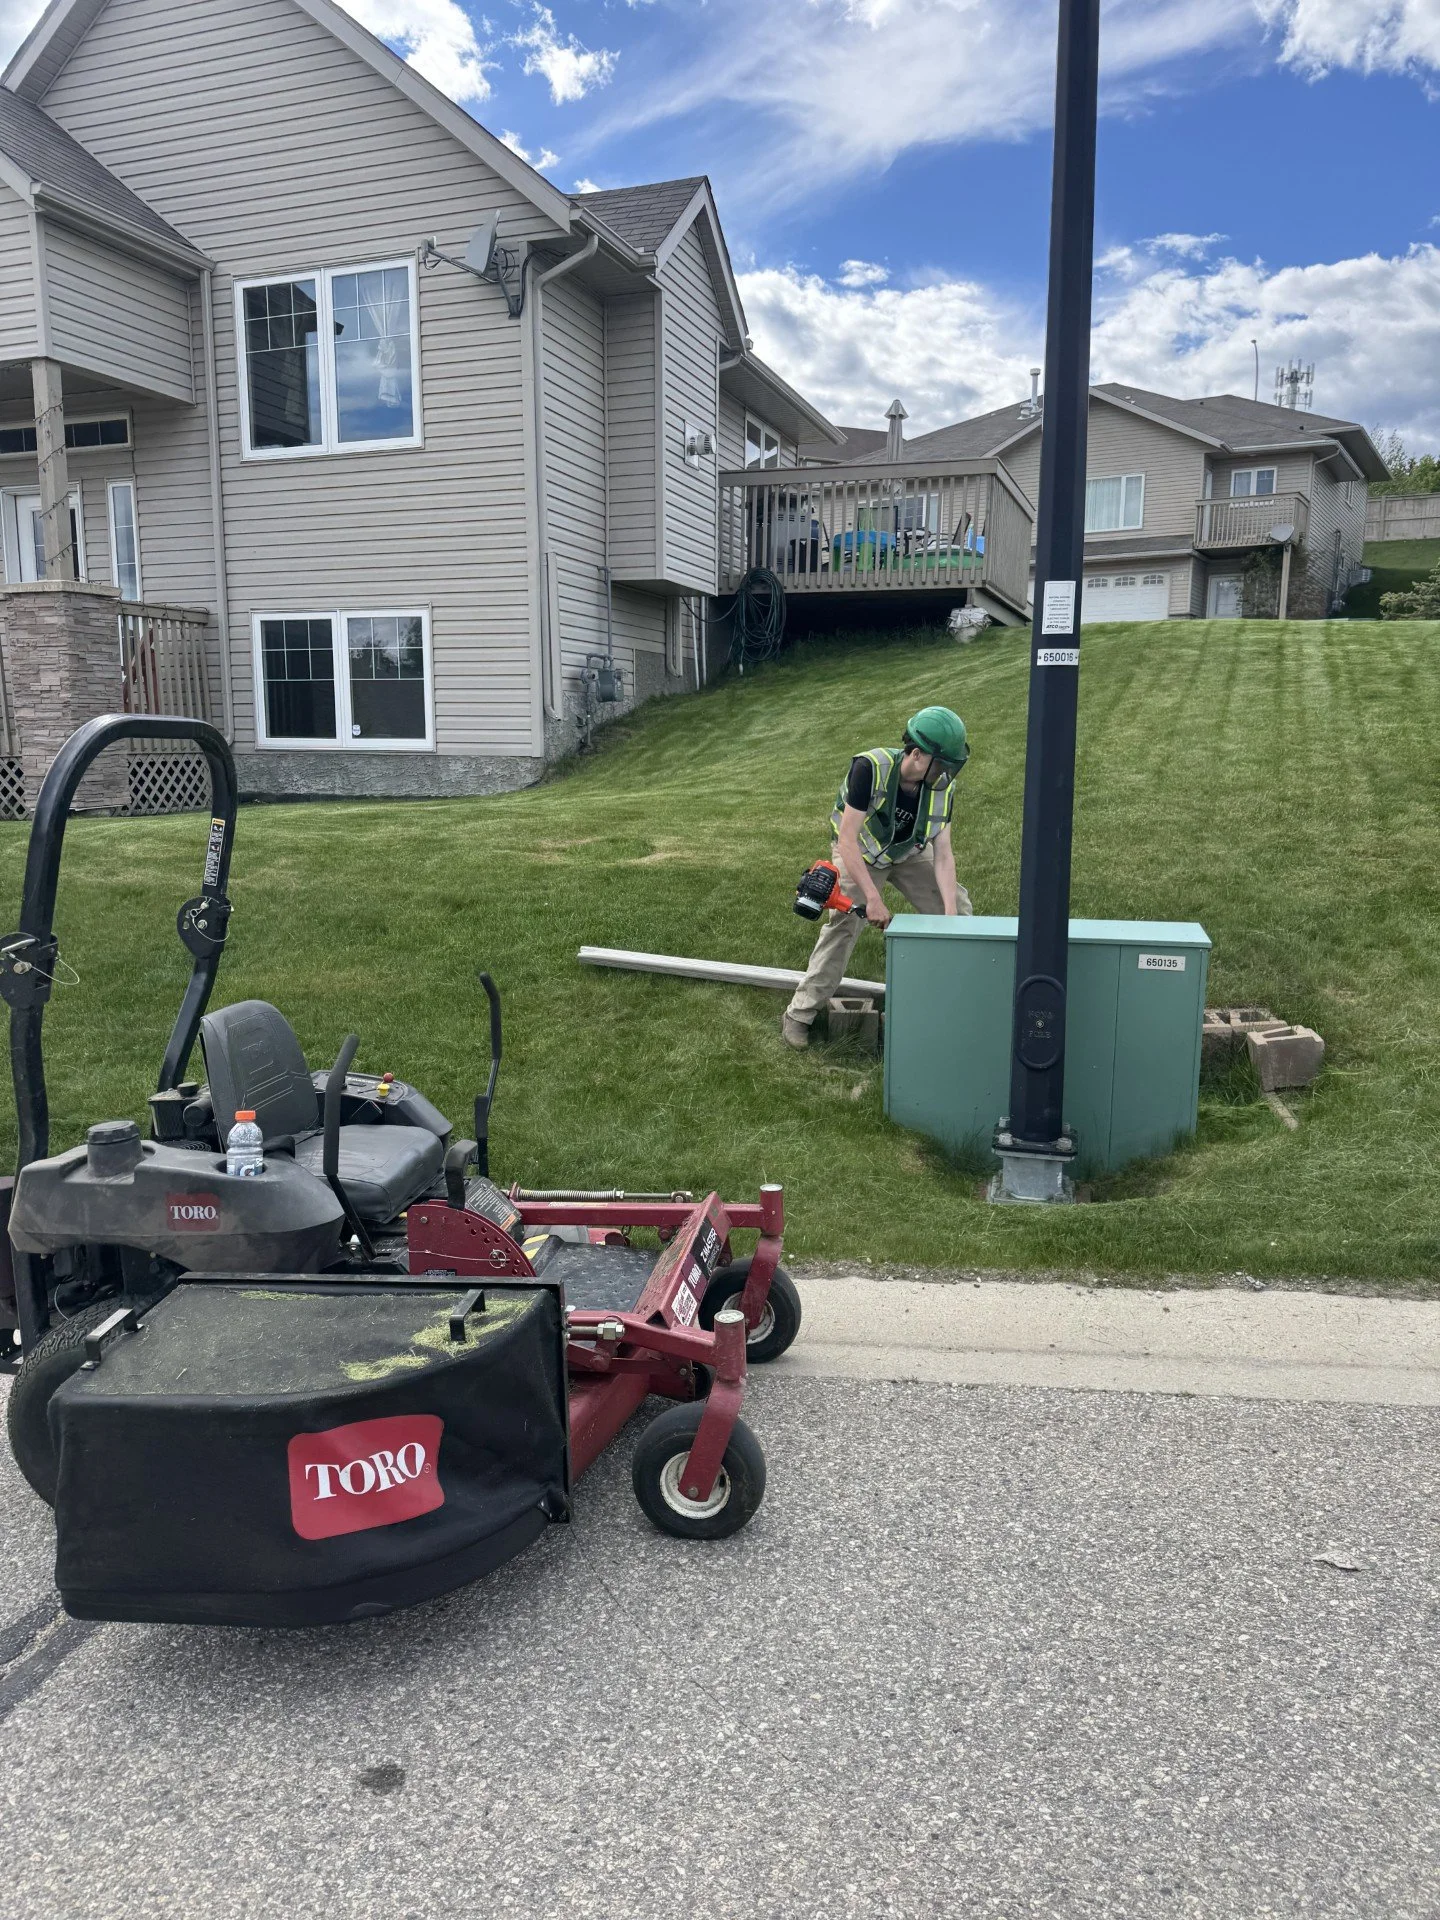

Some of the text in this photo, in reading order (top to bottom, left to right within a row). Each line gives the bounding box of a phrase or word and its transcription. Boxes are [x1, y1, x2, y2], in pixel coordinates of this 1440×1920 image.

[1043, 652, 1074, 662] 650016
[1146, 957, 1178, 968] 650135
[170, 1205, 217, 1220] TORO
[688, 1263, 702, 1289] TORO
[305, 1442, 426, 1501] TORO
